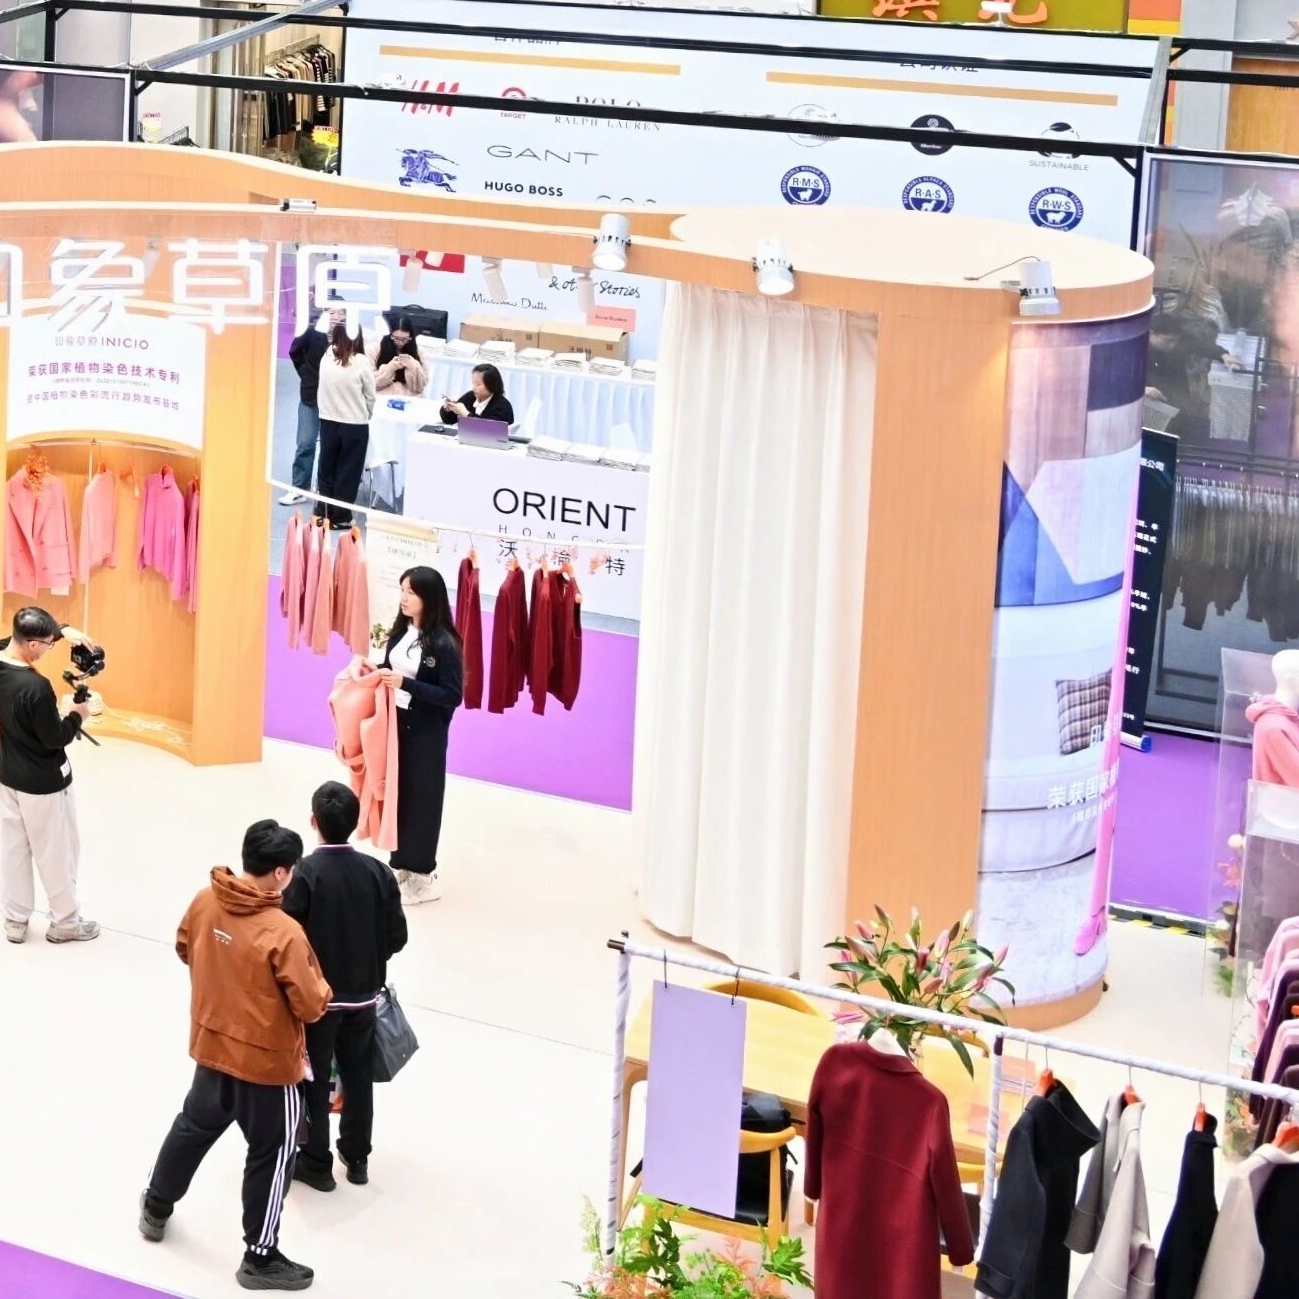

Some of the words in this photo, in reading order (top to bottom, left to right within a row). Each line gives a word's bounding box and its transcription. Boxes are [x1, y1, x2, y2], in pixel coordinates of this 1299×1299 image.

[486, 144, 599, 166] GANT
[1028, 159, 1090, 172] SUSTAINABLE
[484, 179, 526, 195] HUGO
[529, 182, 564, 198] BOSS
[101, 336, 150, 351] INICIO
[493, 487, 637, 532] ORIENT
